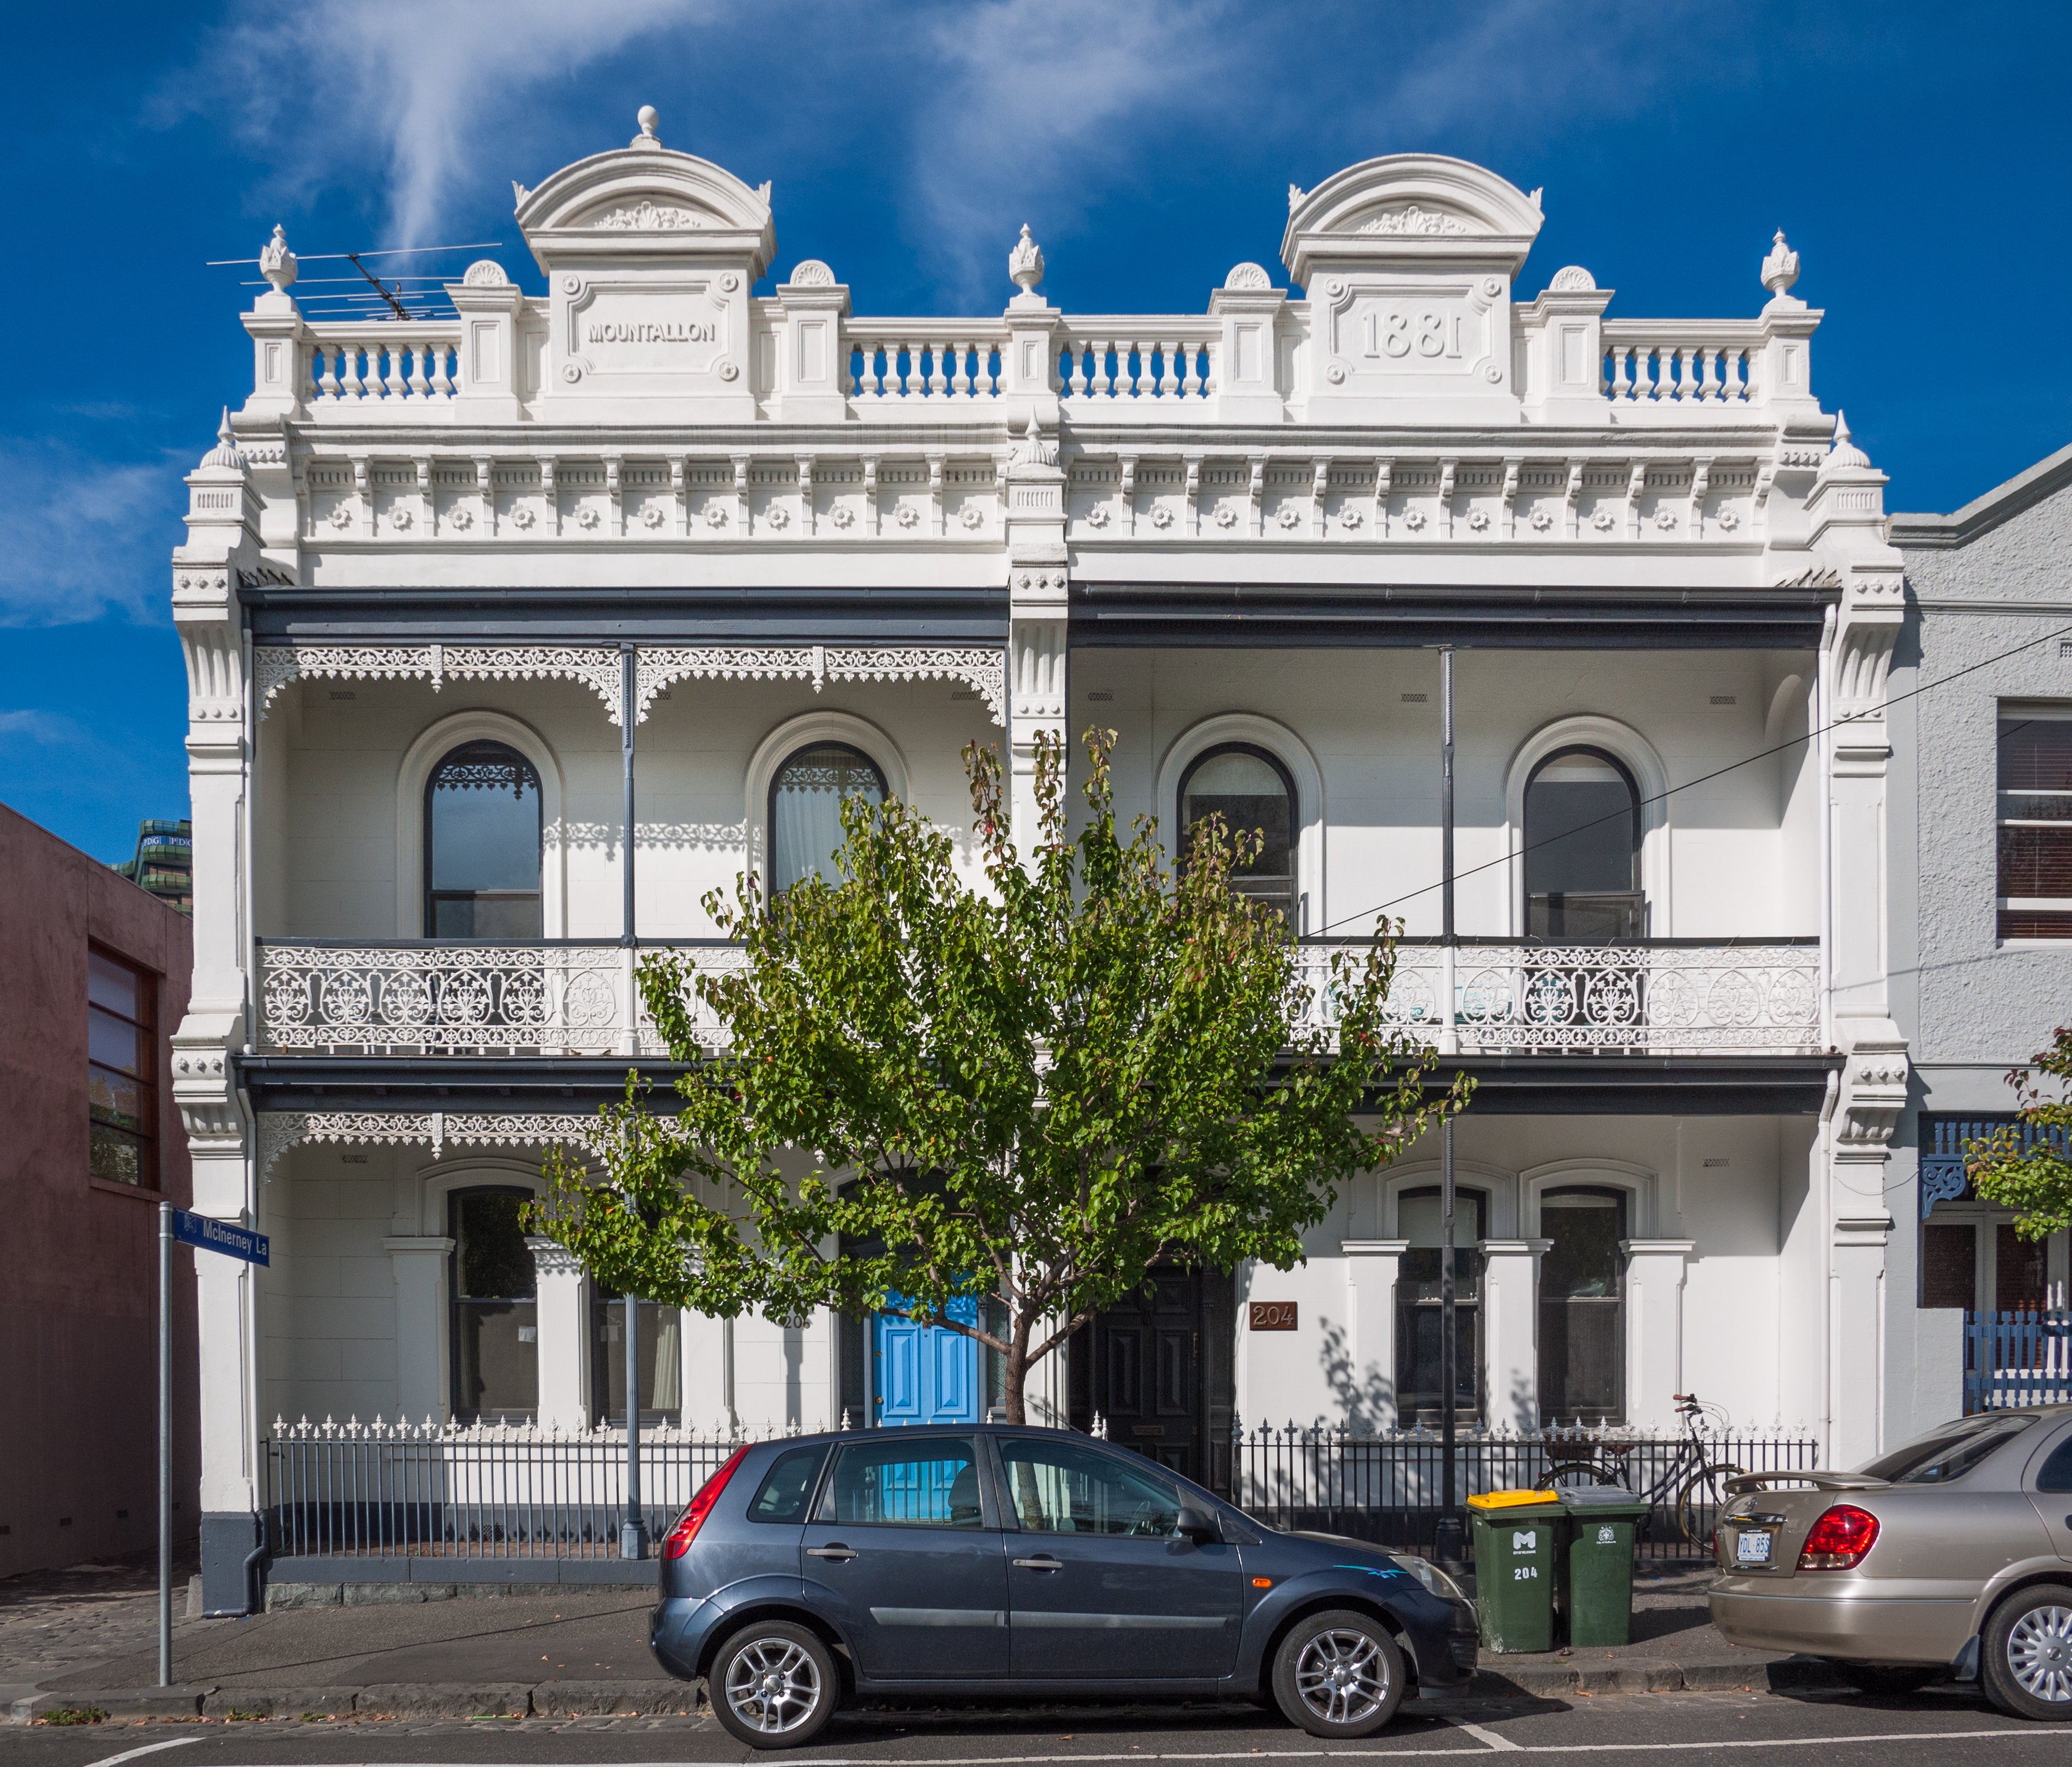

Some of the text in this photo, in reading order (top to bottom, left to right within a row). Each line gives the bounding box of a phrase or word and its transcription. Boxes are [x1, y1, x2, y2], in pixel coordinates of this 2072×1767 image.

[589, 323, 715, 343] MOUNTALLON
[1363, 310, 1462, 359] 1881
[203, 1219, 267, 1256] McInerney La
[1253, 1305, 1294, 1326] 204
[1740, 1537, 1751, 1553] YDL
[1514, 1566, 1538, 1580] 204
